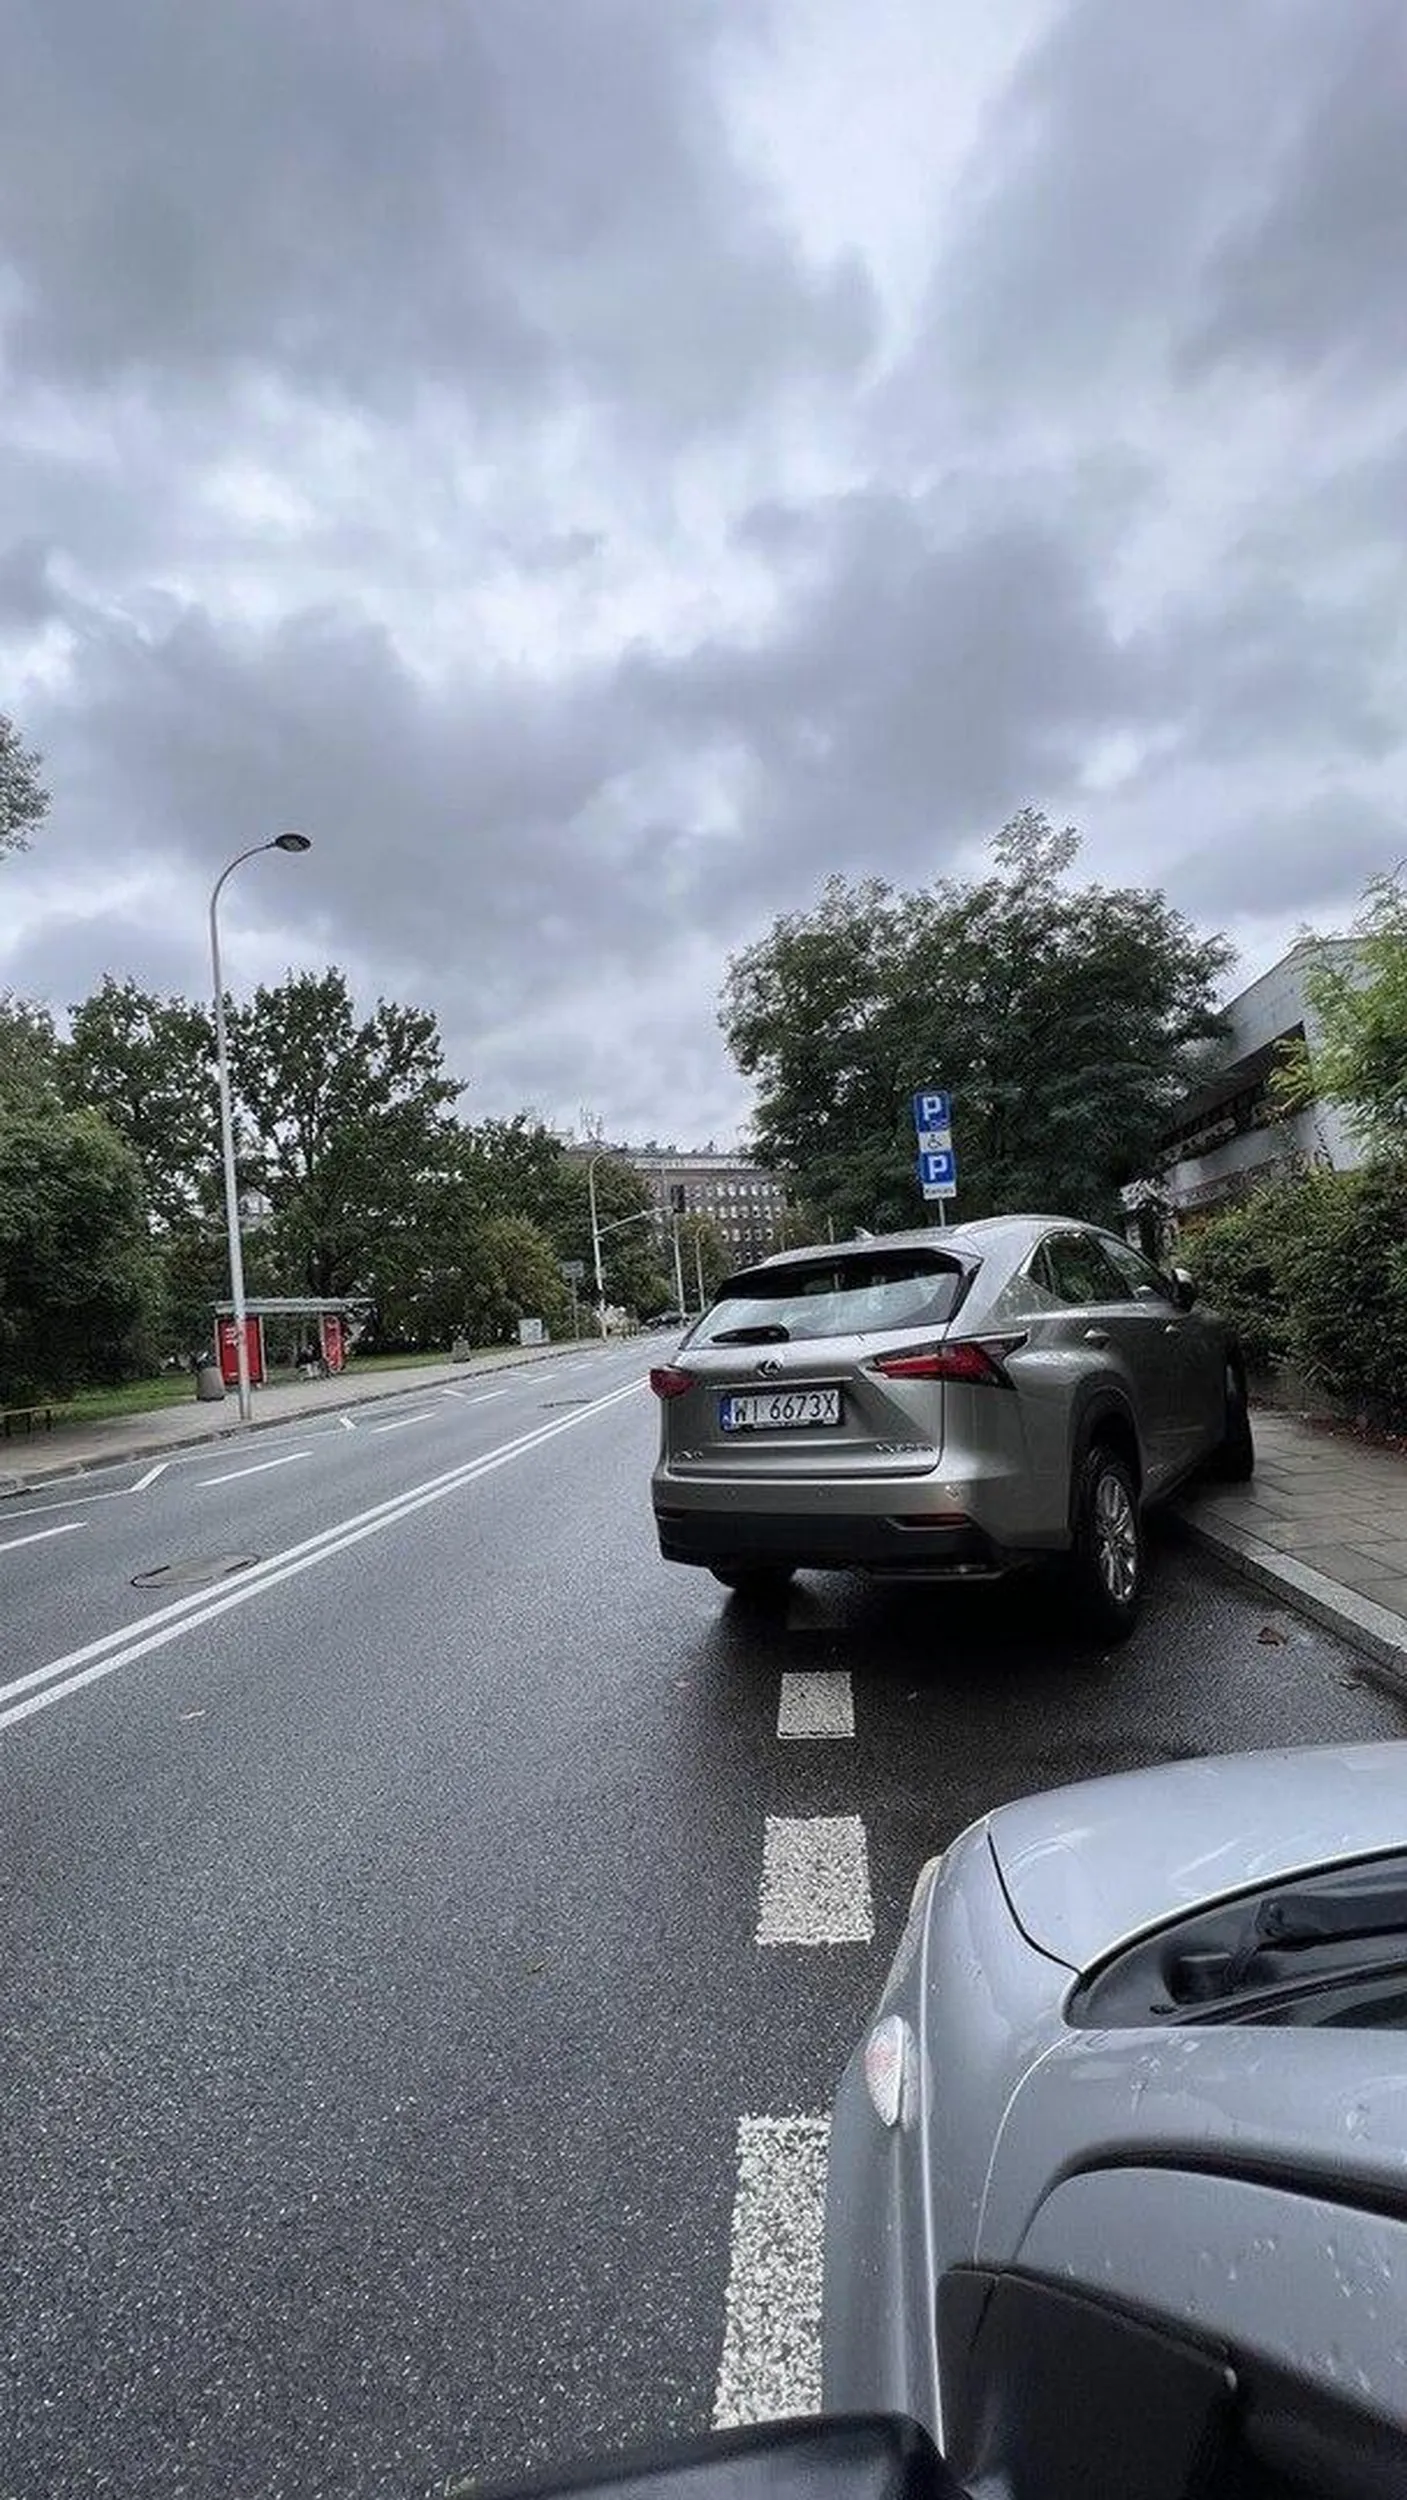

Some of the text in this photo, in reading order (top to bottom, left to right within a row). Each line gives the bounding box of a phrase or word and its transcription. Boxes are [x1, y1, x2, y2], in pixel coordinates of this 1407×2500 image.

[922, 1096, 941, 1121] P
[928, 1154, 949, 1180] P
[769, 1393, 836, 1419] 6673X
